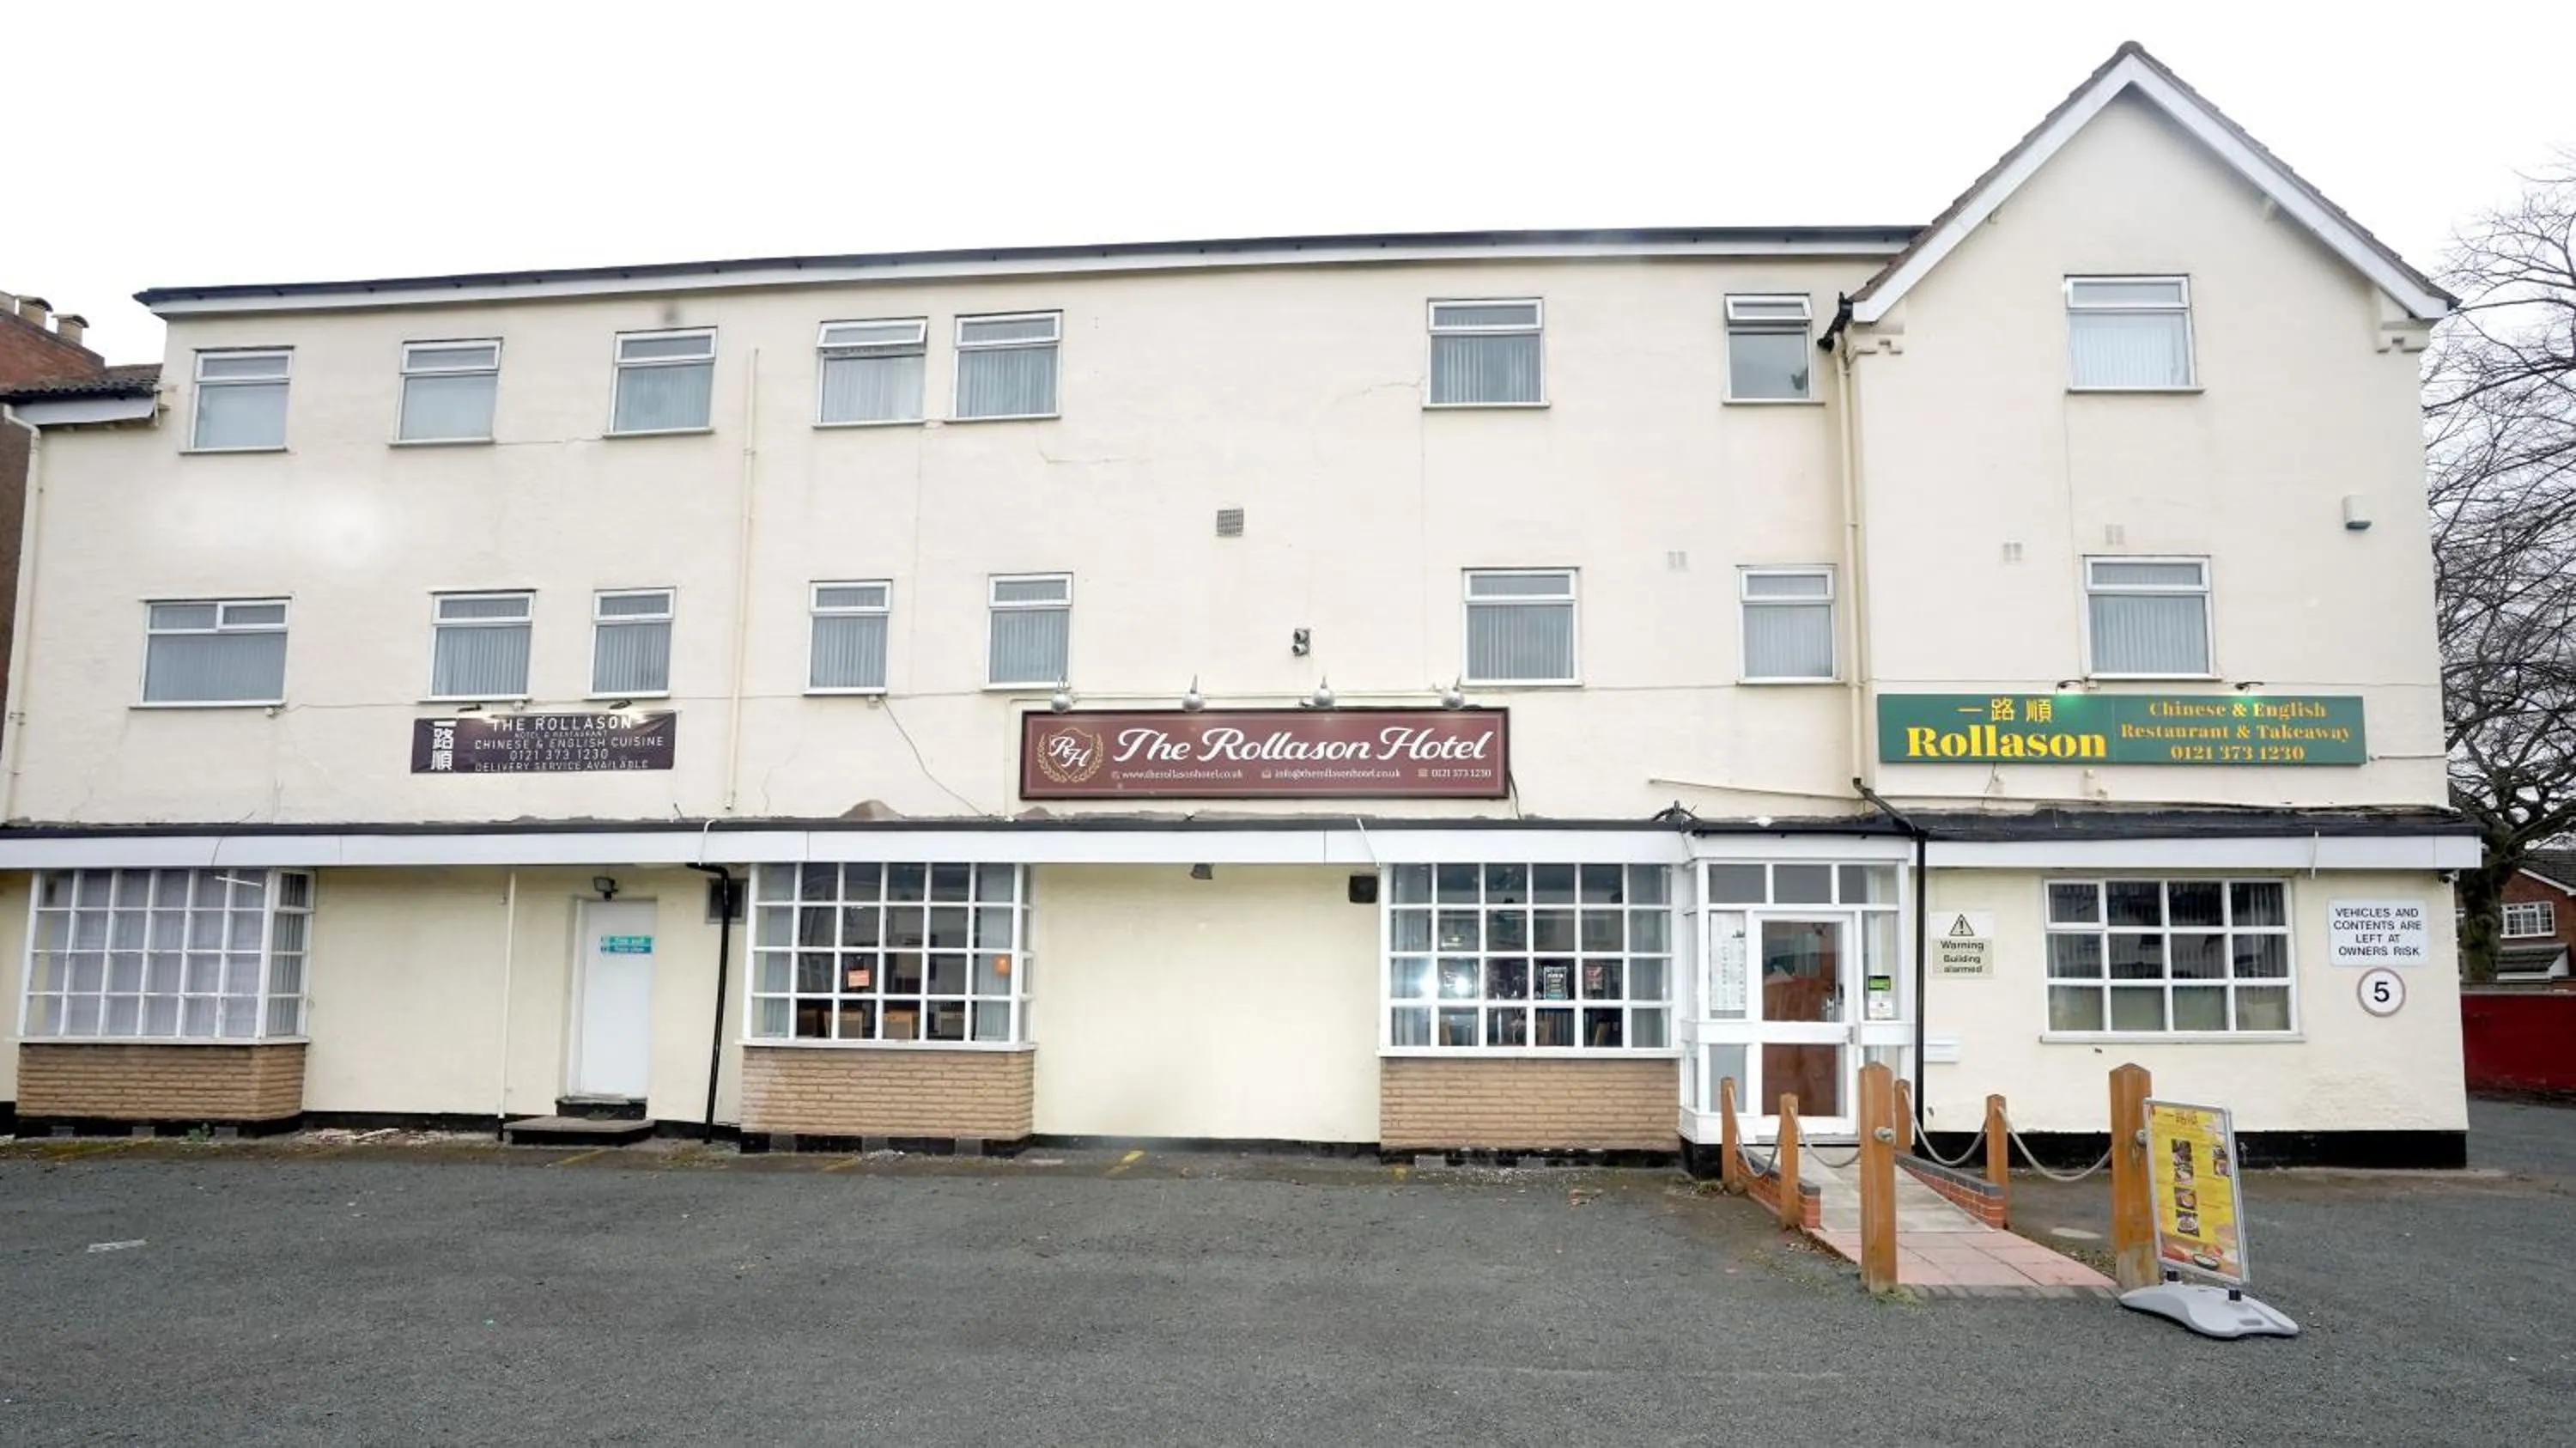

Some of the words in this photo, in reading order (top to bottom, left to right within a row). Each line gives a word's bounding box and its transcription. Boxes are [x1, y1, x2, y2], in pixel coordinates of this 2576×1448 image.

[1957, 697, 2052, 723] 一路順
[2150, 701, 2226, 717] Chinese
[2232, 703, 2246, 717] &
[2253, 701, 2326, 720] English
[492, 717, 526, 732] THE
[535, 715, 631, 731] ROLLASON
[2121, 724, 2229, 739] Restaurant
[2236, 725, 2250, 739] &
[2257, 725, 2349, 742] Takeaway
[430, 721, 457, 770] 一路順
[475, 739, 529, 750] CHINESE
[536, 739, 543, 748] &
[550, 738, 605, 748] ENGLISH
[611, 736, 664, 747] CUISINE
[1113, 727, 1192, 761] The
[1197, 727, 1371, 761] Rollason
[1376, 727, 1494, 760] Hotel
[1905, 724, 2108, 757] Rollason
[509, 750, 539, 761] 0121
[545, 749, 569, 760] 373
[577, 748, 609, 760] 1230
[2171, 745, 2213, 760] 0121
[2221, 745, 2253, 760] 373
[2260, 745, 2306, 760] 1230
[475, 762, 529, 772] DELIVERY
[2335, 908, 2391, 918] VEHICLES
[2395, 908, 2419, 917] AND
[2333, 920, 2395, 930] CONTENTS
[2400, 921, 2421, 930] ARE
[1941, 940, 1984, 952] Warning
[2355, 934, 2382, 944] LEFT
[2388, 934, 2402, 943] AT
[2338, 946, 2388, 956] OWNERS
[2393, 946, 2420, 956] RISK
[1944, 954, 1981, 964] Building
[2373, 981, 2390, 1003] 5
